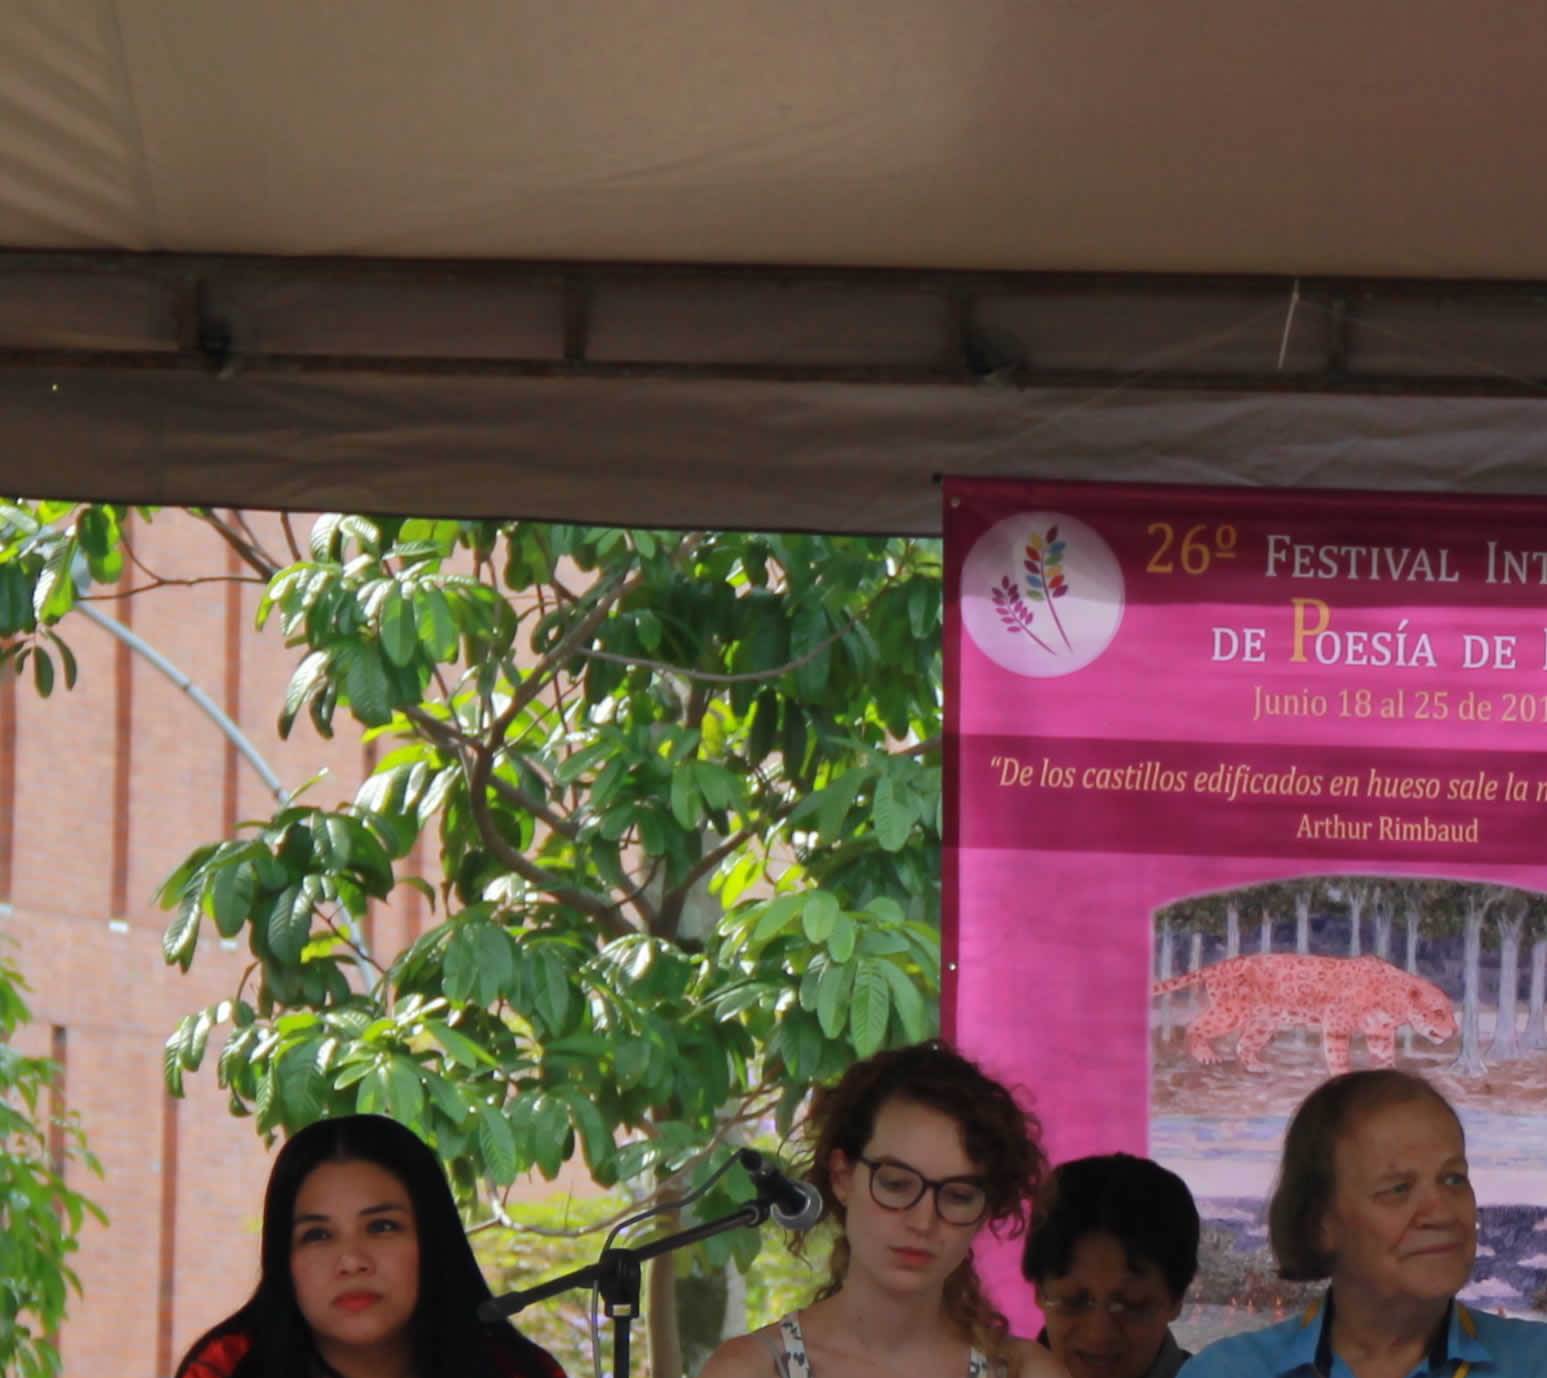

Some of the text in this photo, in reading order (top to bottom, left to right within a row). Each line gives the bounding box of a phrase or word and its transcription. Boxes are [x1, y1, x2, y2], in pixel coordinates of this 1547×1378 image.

[1265, 534, 1460, 583] FESTIVAL
[1211, 627, 1266, 662] DE
[1289, 597, 1438, 667] POESÍA
[1462, 634, 1517, 670] DE
[1253, 686, 1328, 721] Junio
[1338, 689, 1372, 719] 18
[1380, 689, 1404, 719] al
[1413, 691, 1449, 721] 25
[1458, 692, 1492, 721] de
[1040, 758, 1075, 789] los
[1082, 761, 1187, 793] castillos
[1193, 764, 1323, 801] edificados
[1329, 773, 1362, 798] en
[1367, 768, 1441, 800] hueso
[1447, 771, 1498, 801] sale
[1505, 772, 1529, 802] la
[1296, 814, 1479, 844] Arthur Rimbaud
